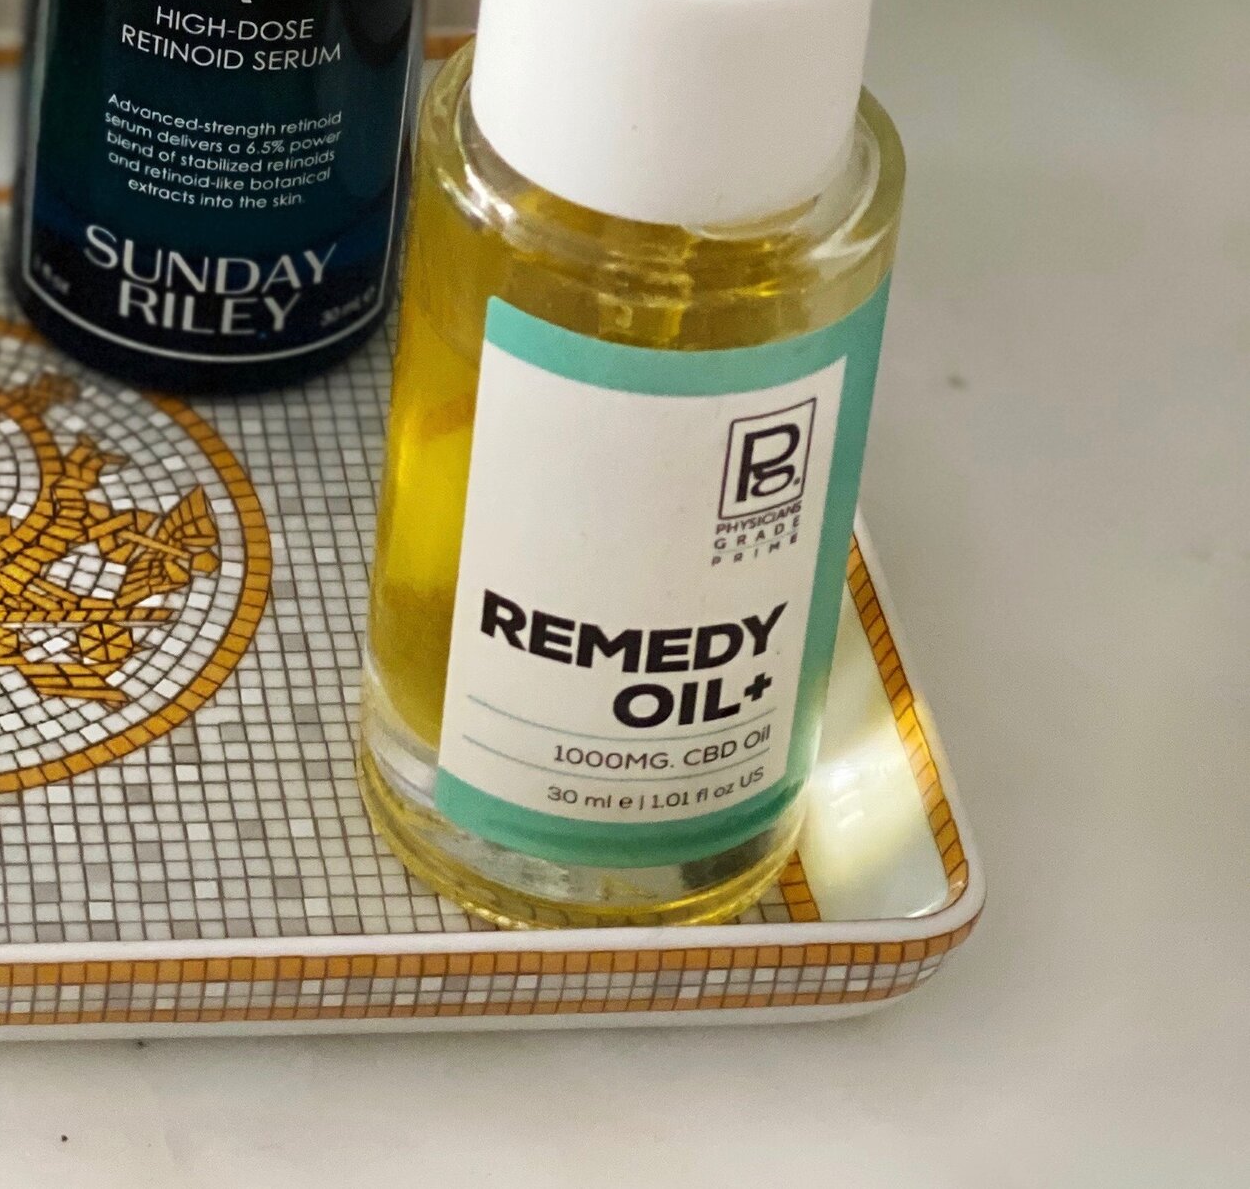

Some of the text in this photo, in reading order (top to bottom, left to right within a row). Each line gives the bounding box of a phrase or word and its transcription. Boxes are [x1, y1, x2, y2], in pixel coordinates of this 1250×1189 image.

[156, 5, 314, 41] HIGH-DOSE
[121, 24, 342, 71] RETINOID SERUM
[104, 111, 342, 155] serum delivers a 6.5% power
[108, 93, 342, 139] Advanced-strength retinoid
[106, 130, 335, 173] blend of stabilized retinoids
[108, 151, 330, 192] and retinoid-like botanical
[128, 177, 195, 206] extracts
[200, 192, 233, 209] into
[239, 194, 267, 209] the
[83, 223, 338, 295] SUNDAY
[118, 279, 302, 336] RILEY
[713, 514, 801, 551] GRADE
[715, 499, 803, 536] PHYSICIANS
[711, 532, 798, 567] PRIME
[479, 588, 789, 675] REMEDY
[553, 724, 771, 771] 1000MG. CBD Oil
[547, 785, 578, 806] 30
[585, 793, 611, 809] ml
[714, 782, 735, 799] oz
[740, 766, 765, 791] US
